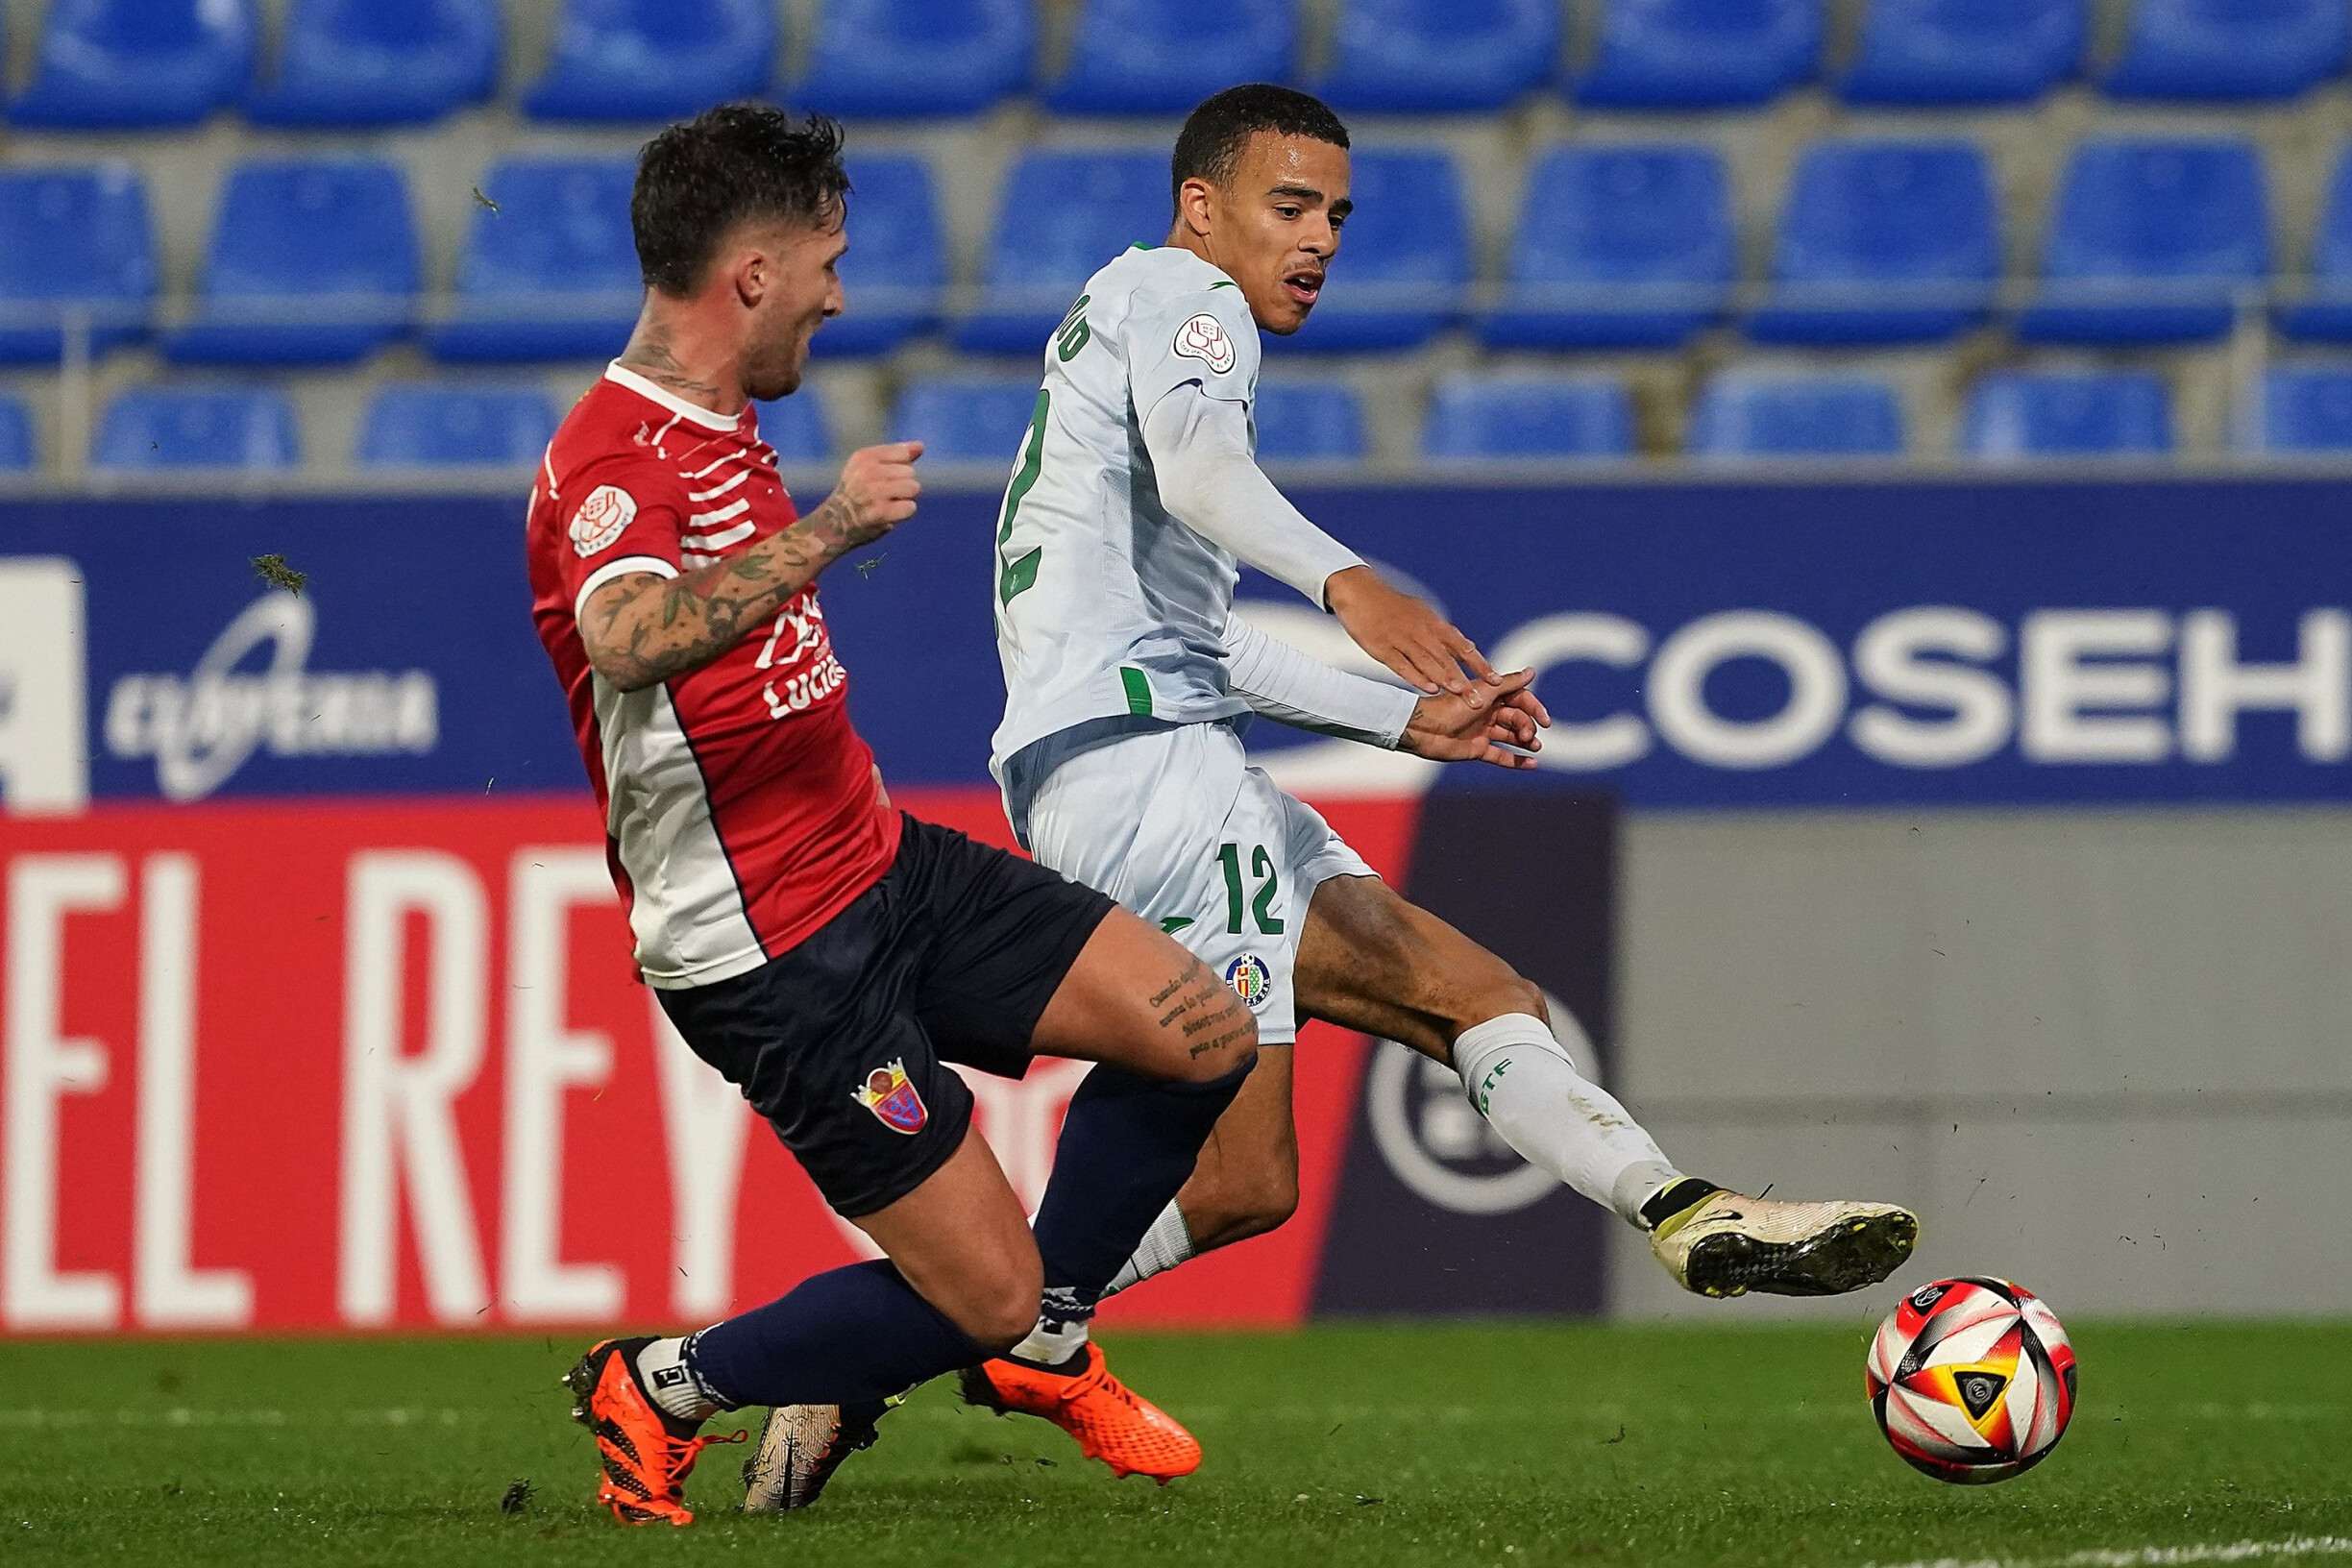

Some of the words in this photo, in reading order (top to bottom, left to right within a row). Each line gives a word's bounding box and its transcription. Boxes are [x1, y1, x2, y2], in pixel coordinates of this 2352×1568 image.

[1214, 842, 1286, 936] 12
[2, 849, 256, 1331] EL
[336, 845, 753, 1332] REY
